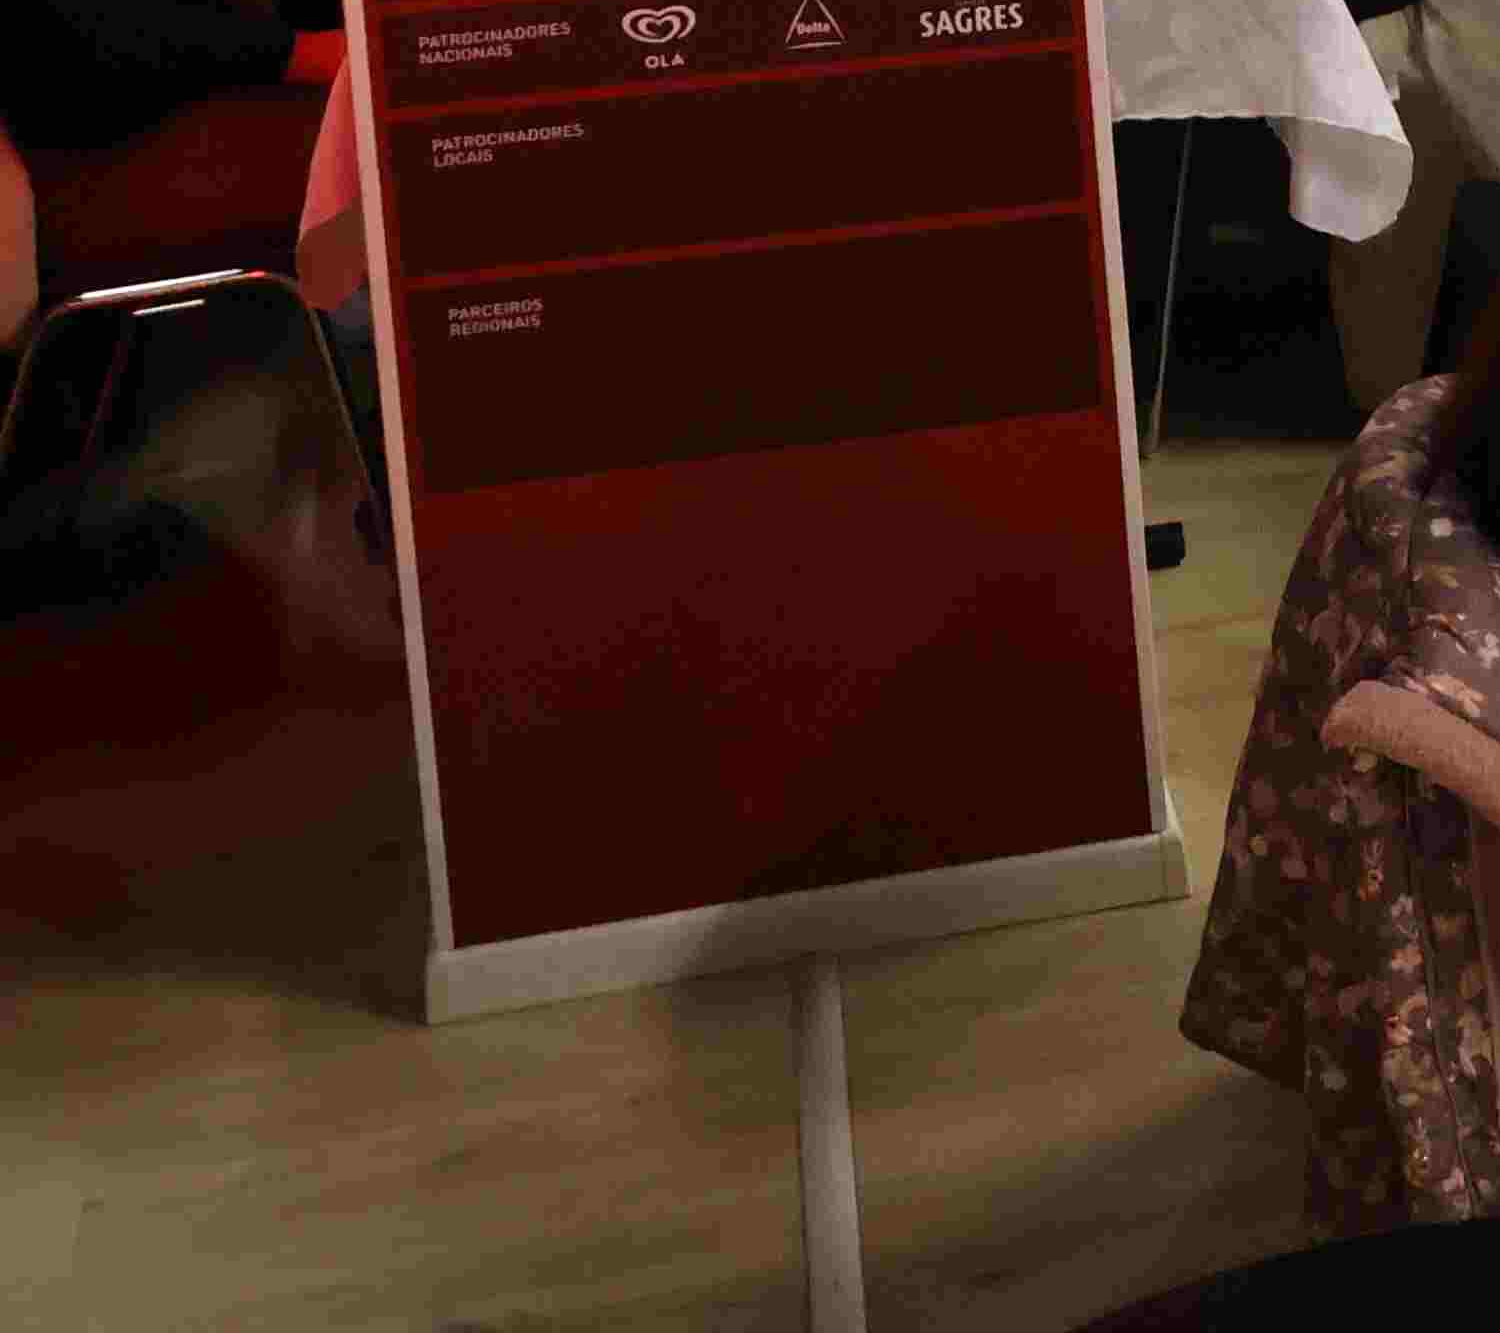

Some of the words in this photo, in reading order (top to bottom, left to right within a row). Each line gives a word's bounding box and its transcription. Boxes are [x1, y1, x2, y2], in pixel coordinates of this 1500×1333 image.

[920, 3, 1023, 37] SAGRES
[418, 21, 571, 49] PATROCINADORES
[419, 43, 513, 64] NACIONAIS
[432, 123, 585, 152] PATROCINADORES
[433, 148, 494, 168] LOCAIS
